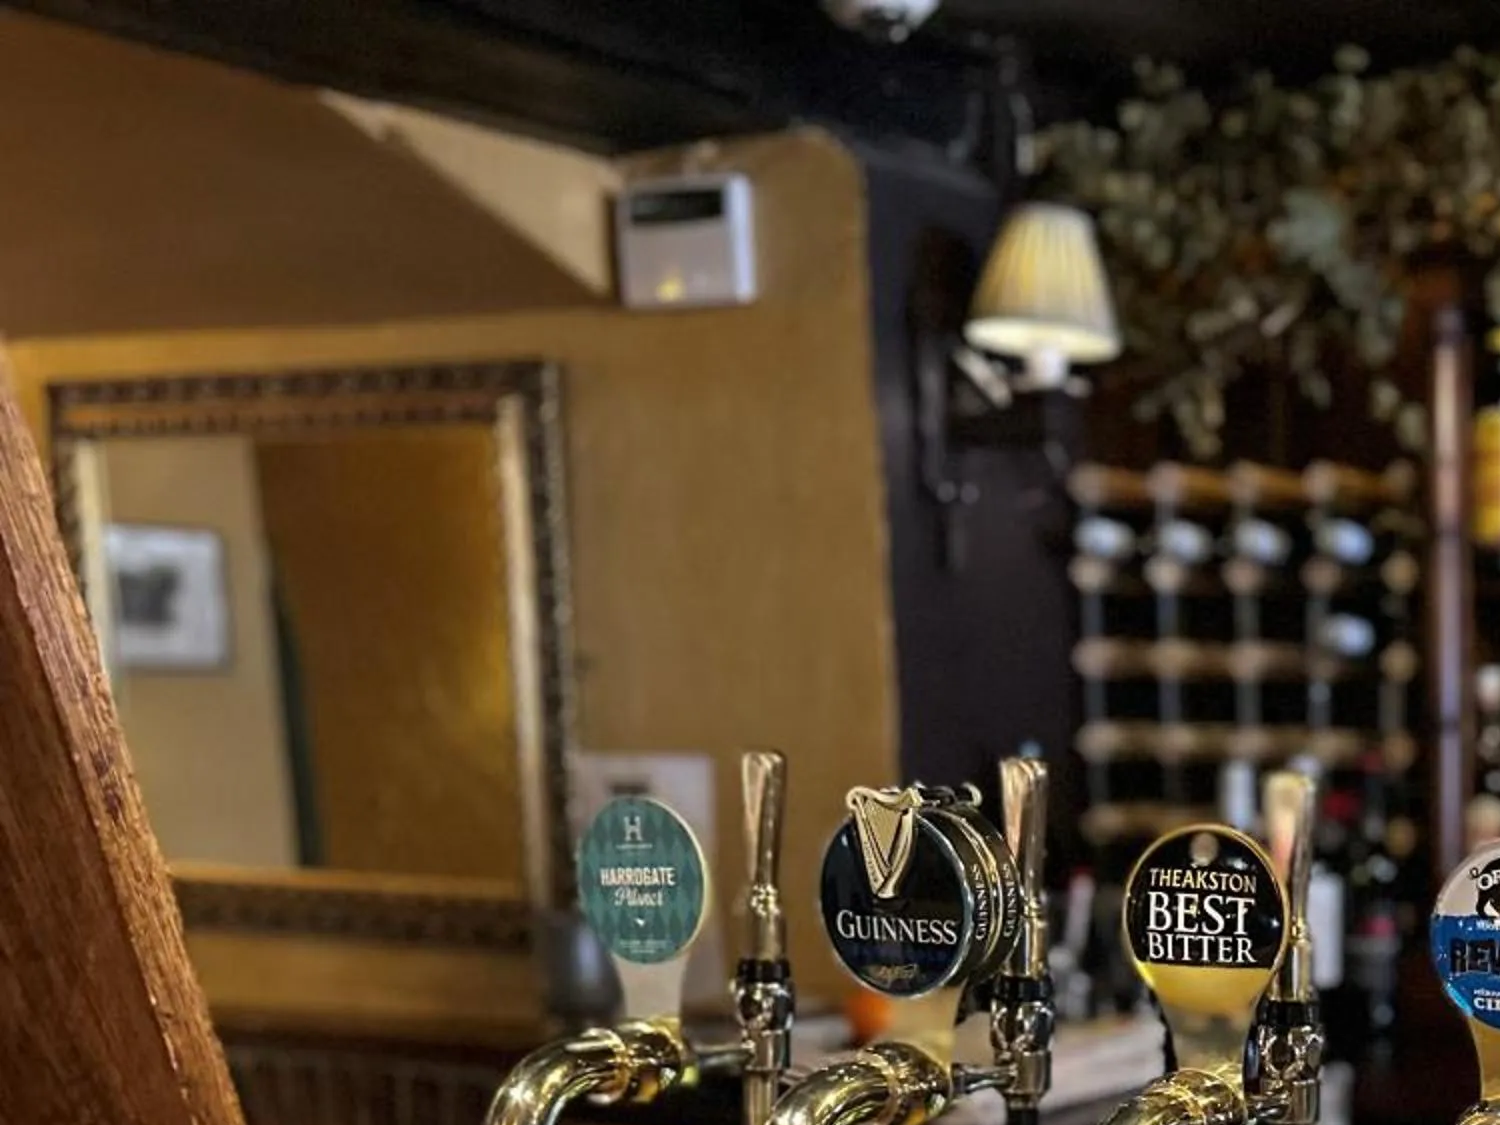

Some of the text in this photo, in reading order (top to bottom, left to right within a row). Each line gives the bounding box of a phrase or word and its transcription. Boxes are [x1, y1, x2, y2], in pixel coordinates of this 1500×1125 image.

[600, 866, 676, 886] HARROGATE
[1149, 867, 1257, 893] THEAKSTON
[836, 909, 957, 945] GUINNESS
[1147, 891, 1255, 935] BEST
[1147, 931, 1257, 963] BITTER
